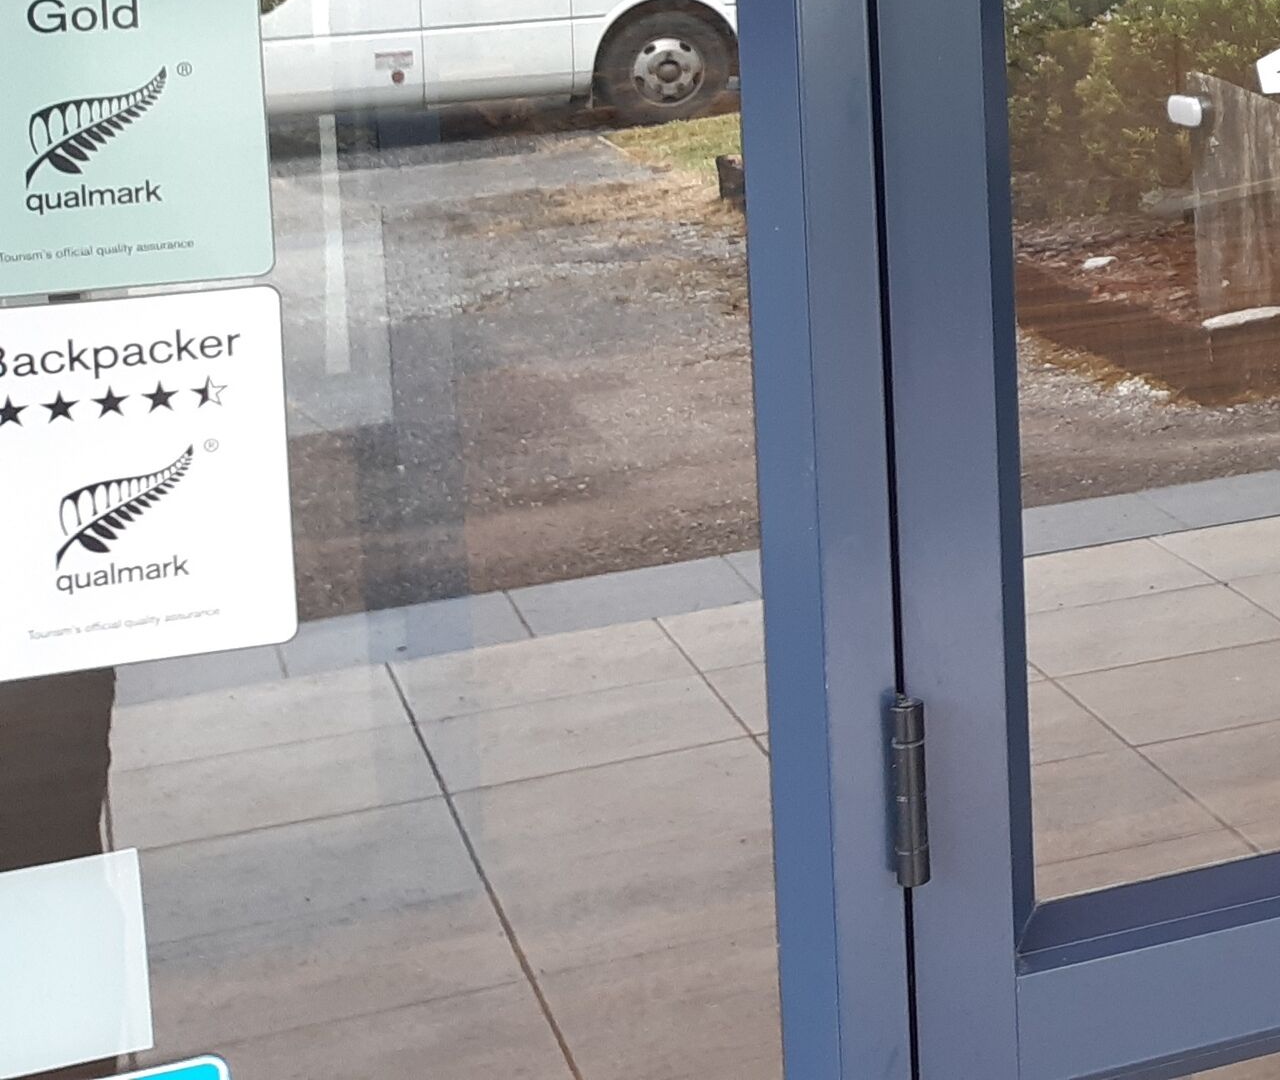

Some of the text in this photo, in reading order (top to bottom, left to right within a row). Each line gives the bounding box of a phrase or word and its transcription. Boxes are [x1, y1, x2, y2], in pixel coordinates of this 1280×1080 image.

[25, 179, 163, 215] qualmark
[0, 239, 196, 262] Tourism's official quality assurance
[55, 555, 190, 595] qualmark
